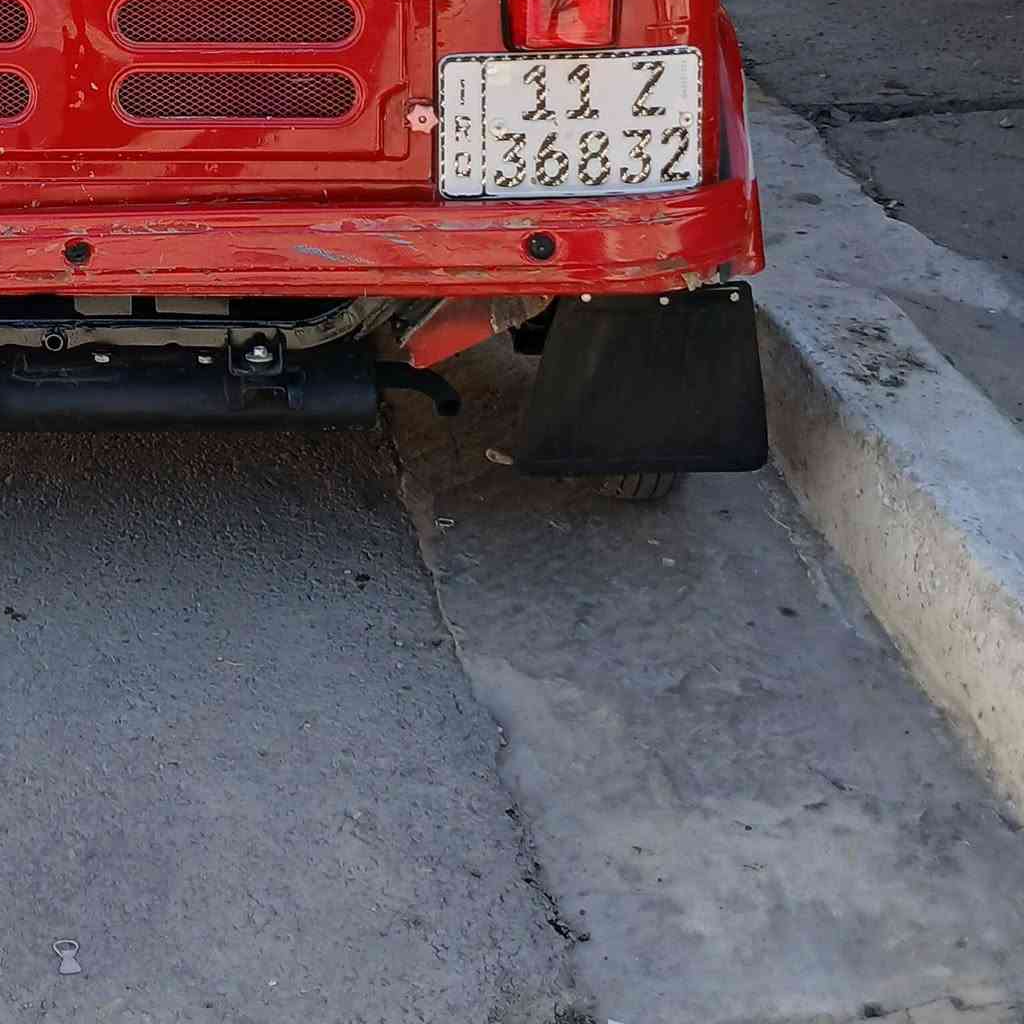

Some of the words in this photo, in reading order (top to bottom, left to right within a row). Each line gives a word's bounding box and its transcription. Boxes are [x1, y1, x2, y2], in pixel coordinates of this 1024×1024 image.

[522, 63, 600, 120] 11
[631, 60, 666, 118] Z
[494, 126, 692, 188] 36832
